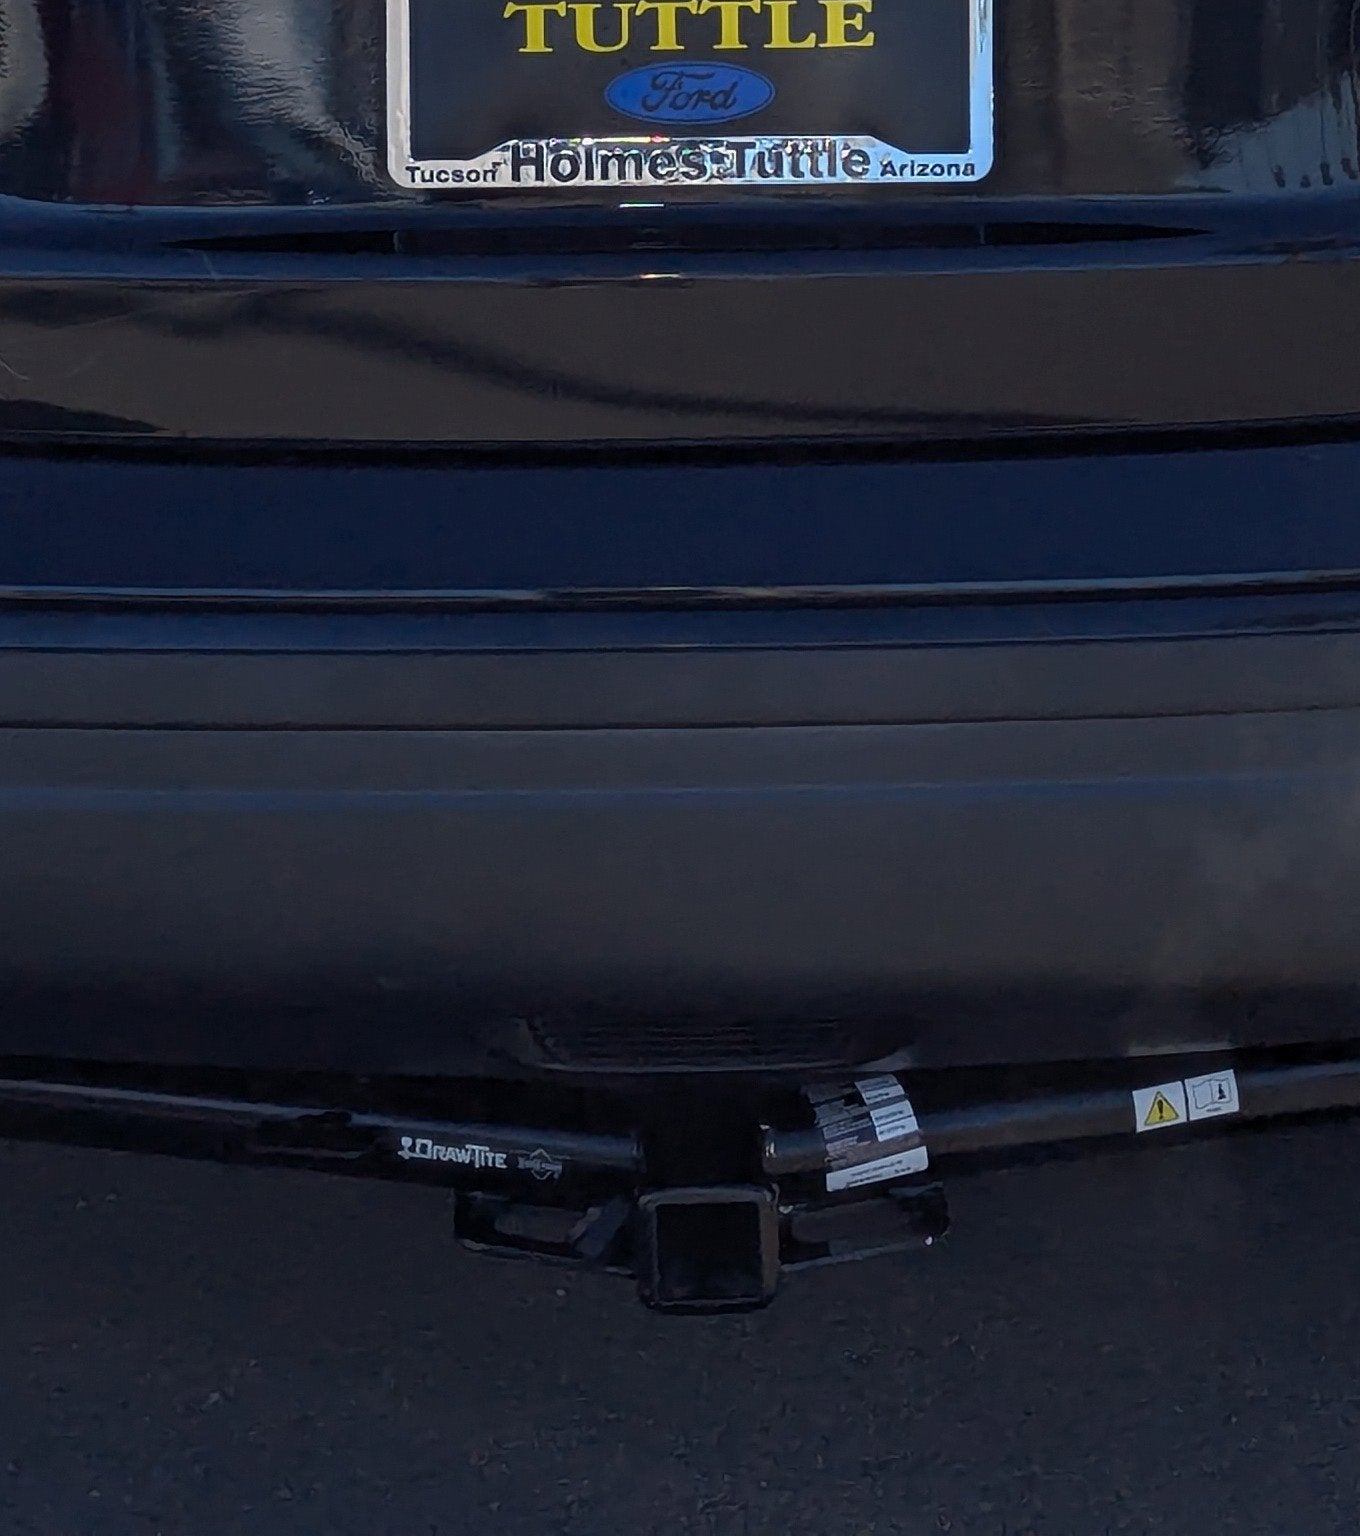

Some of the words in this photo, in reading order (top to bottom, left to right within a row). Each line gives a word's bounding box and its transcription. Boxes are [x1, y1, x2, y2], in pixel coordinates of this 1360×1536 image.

[642, 71, 739, 112] Ford
[405, 165, 497, 184] Tucson
[879, 160, 975, 177] Arizona
